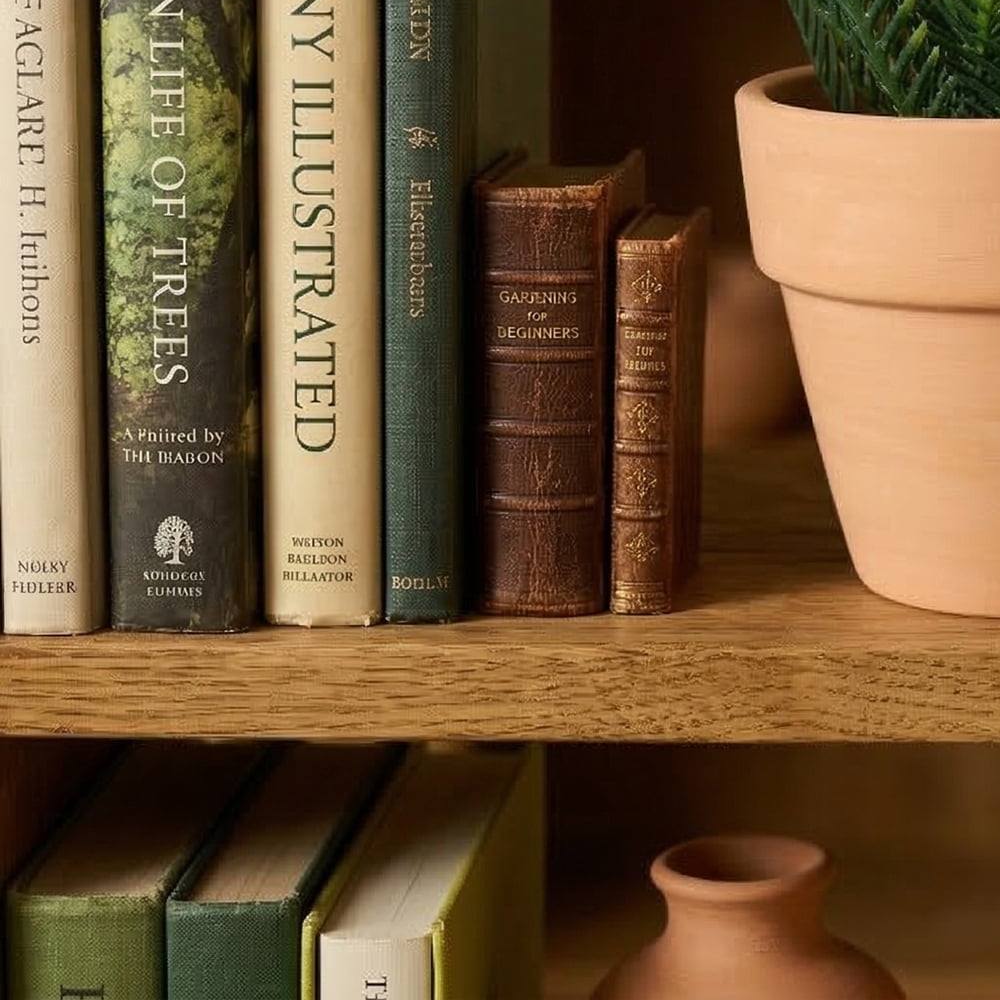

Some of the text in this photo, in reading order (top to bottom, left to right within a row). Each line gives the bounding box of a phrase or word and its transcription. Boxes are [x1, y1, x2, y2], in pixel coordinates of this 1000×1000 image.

[148, 37, 186, 138] LIFE
[149, 155, 187, 219] OF
[150, 236, 189, 385] TREES
[291, 78, 337, 454] ILLUSTRATED
[204, 428, 225, 446] by
